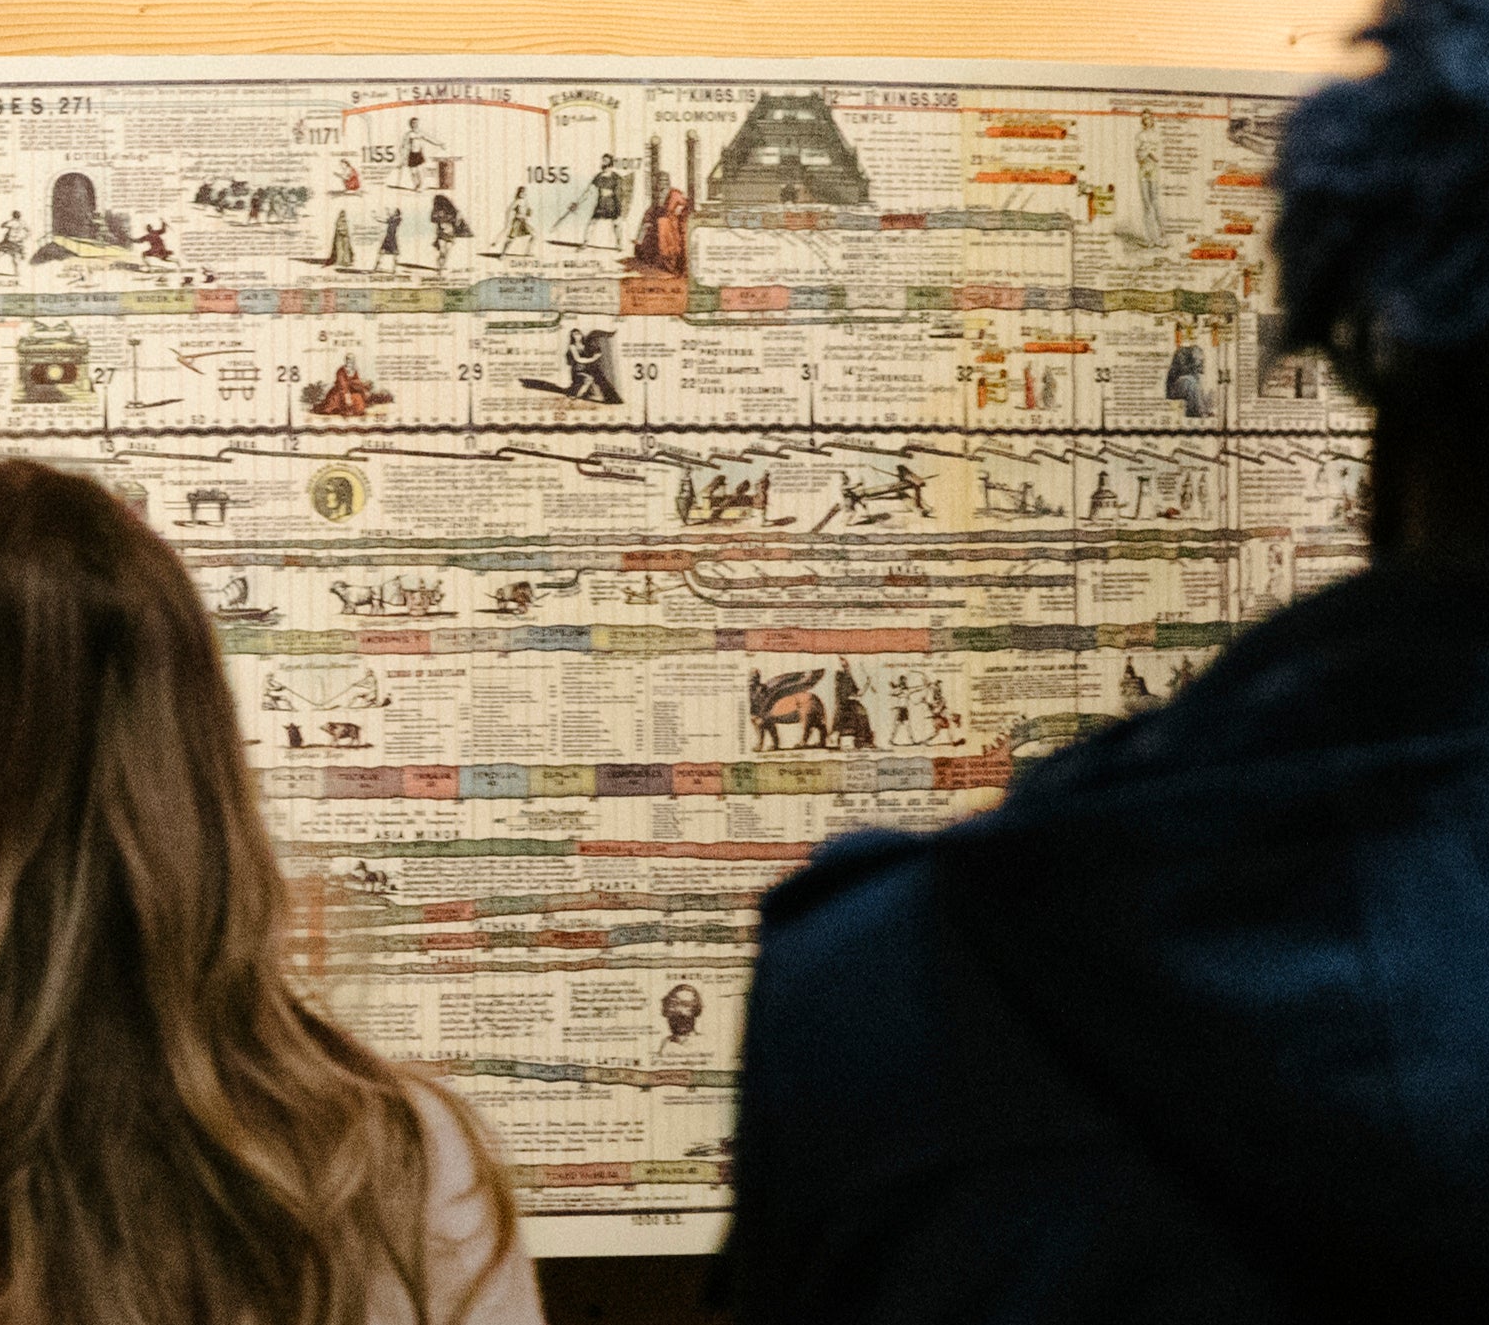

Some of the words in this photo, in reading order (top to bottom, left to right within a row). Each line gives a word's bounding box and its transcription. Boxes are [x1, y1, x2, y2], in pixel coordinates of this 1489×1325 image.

[412, 85, 481, 102] SAMUEL
[882, 91, 929, 106] KINGS.
[654, 111, 737, 123] SOLOMON'S
[309, 128, 340, 145] 1171
[362, 145, 395, 163] 1155
[527, 165, 570, 184] 1055
[95, 368, 115, 385] 27
[277, 365, 301, 383] 28
[459, 364, 482, 380] 29
[633, 364, 658, 380] 30
[802, 364, 819, 381] 31
[282, 436, 299, 451] 12
[640, 435, 655, 450] 10
